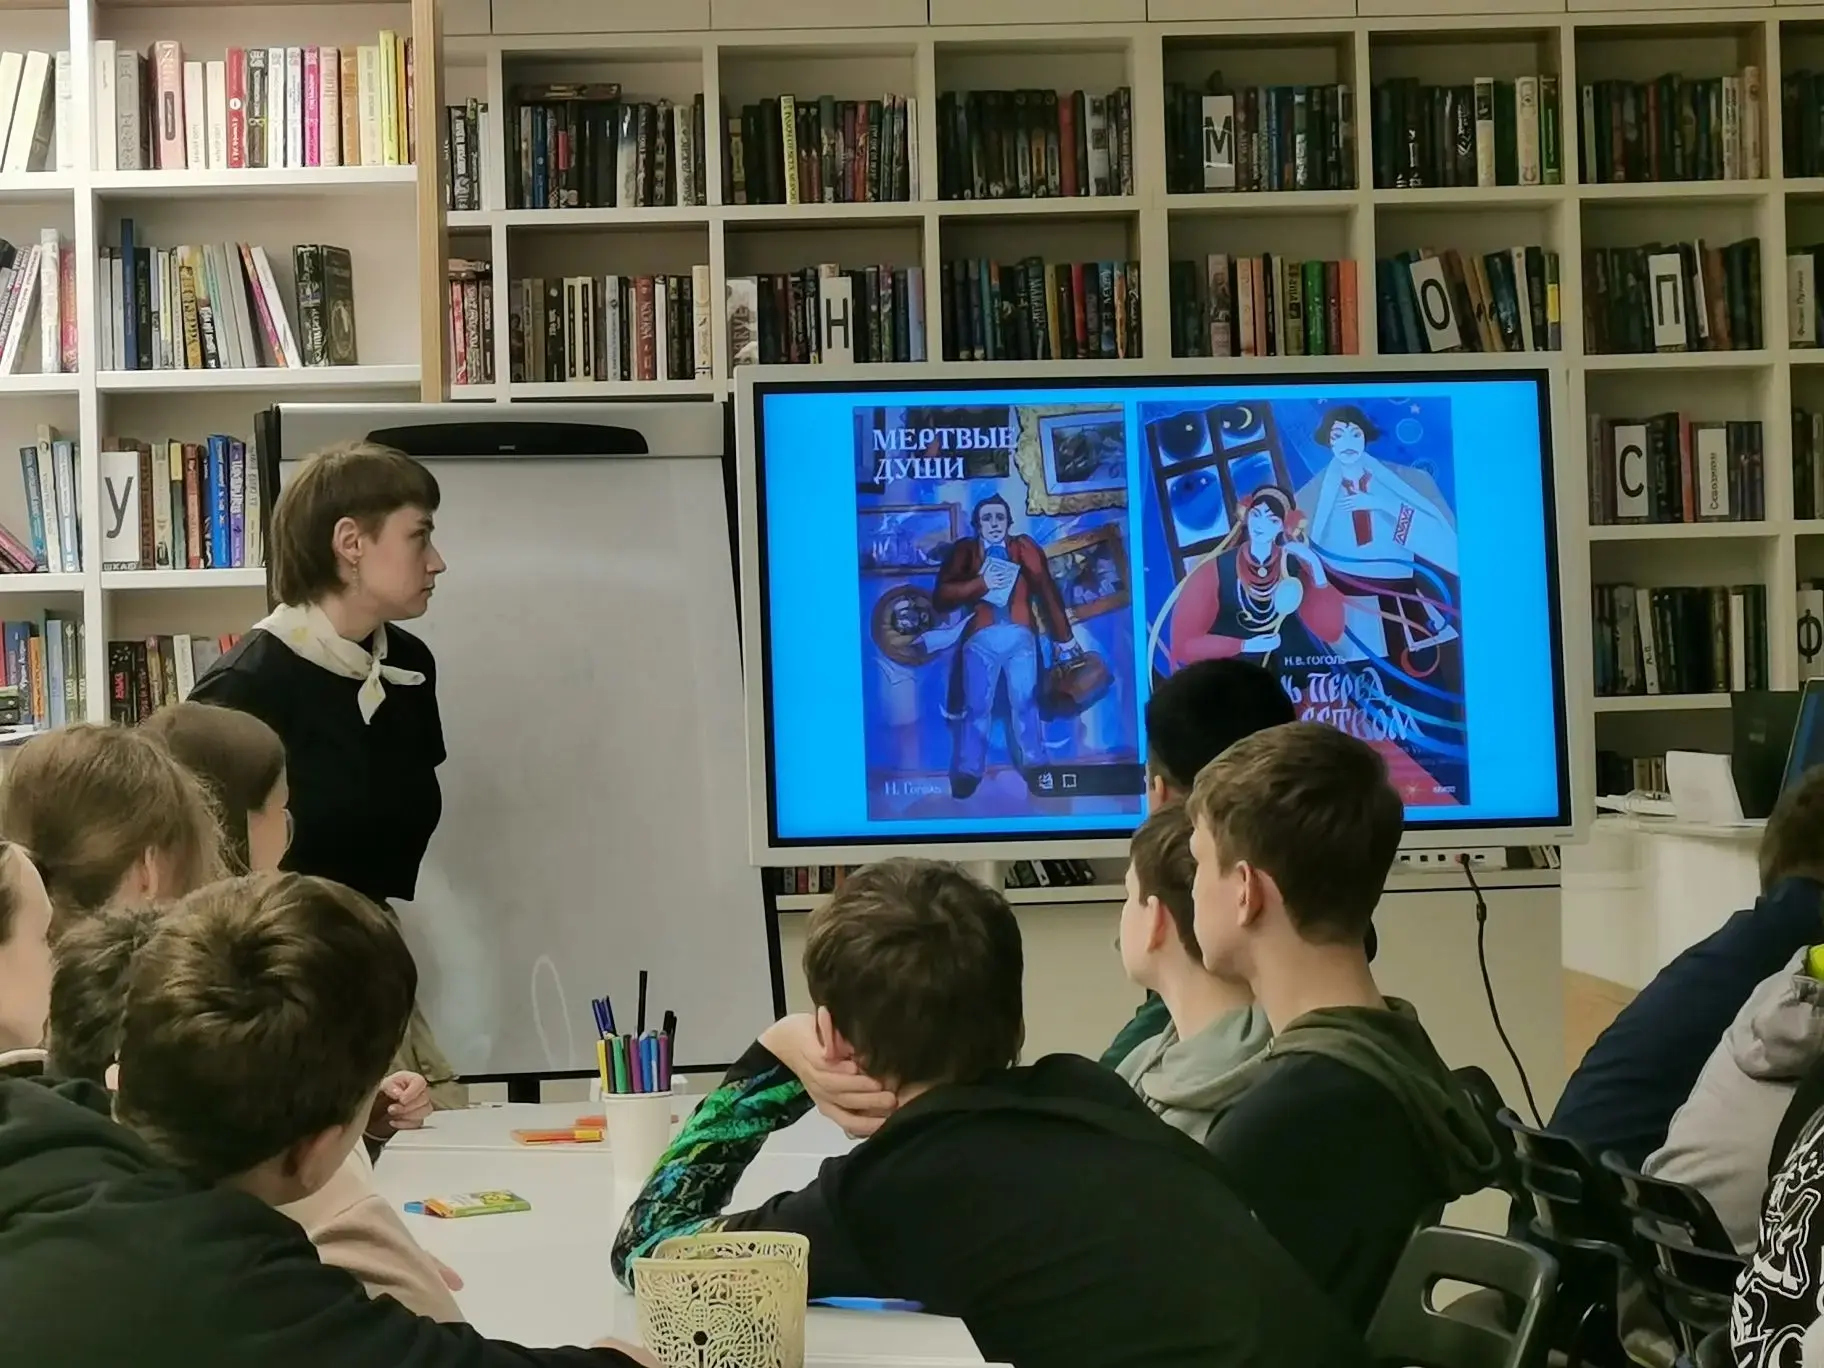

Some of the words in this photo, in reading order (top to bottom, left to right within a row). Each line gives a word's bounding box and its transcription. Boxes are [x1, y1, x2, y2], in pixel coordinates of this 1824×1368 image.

[1203, 115, 1233, 165] М
[825, 297, 850, 350] Н
[1420, 278, 1451, 331] О
[1655, 273, 1681, 326] П
[873, 427, 1018, 451] МЕРТВЫЕ
[873, 457, 965, 484] ДУШИ
[1619, 444, 1645, 498] С
[1797, 608, 1823, 664] Ф
